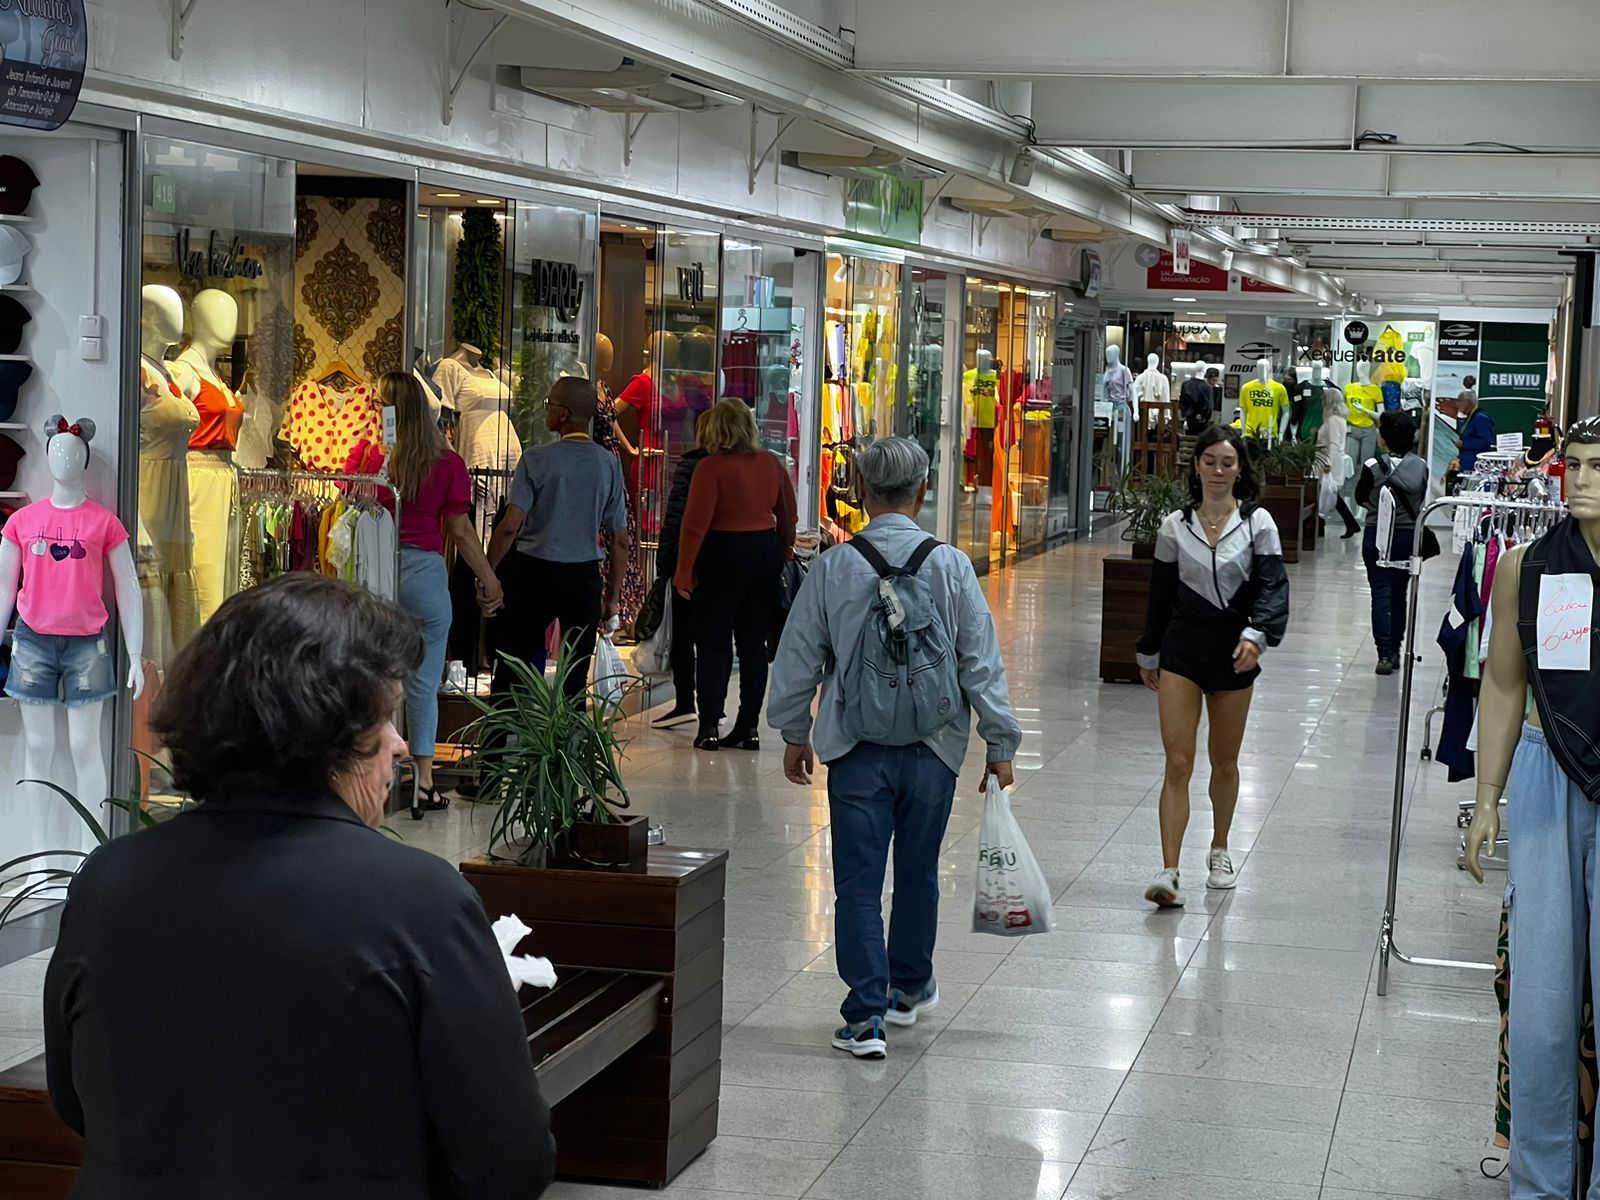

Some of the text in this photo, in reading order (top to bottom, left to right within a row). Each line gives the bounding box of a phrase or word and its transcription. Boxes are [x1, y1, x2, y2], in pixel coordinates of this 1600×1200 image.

[6, 68, 25, 82] Jeans
[51, 76, 73, 90] Juvenil
[17, 85, 43, 101] Tamanho
[2, 98, 29, 113] Atacado
[155, 183, 173, 203] 418
[1439, 338, 1478, 346] mormaii
[1488, 373, 1540, 386] REIWIU
